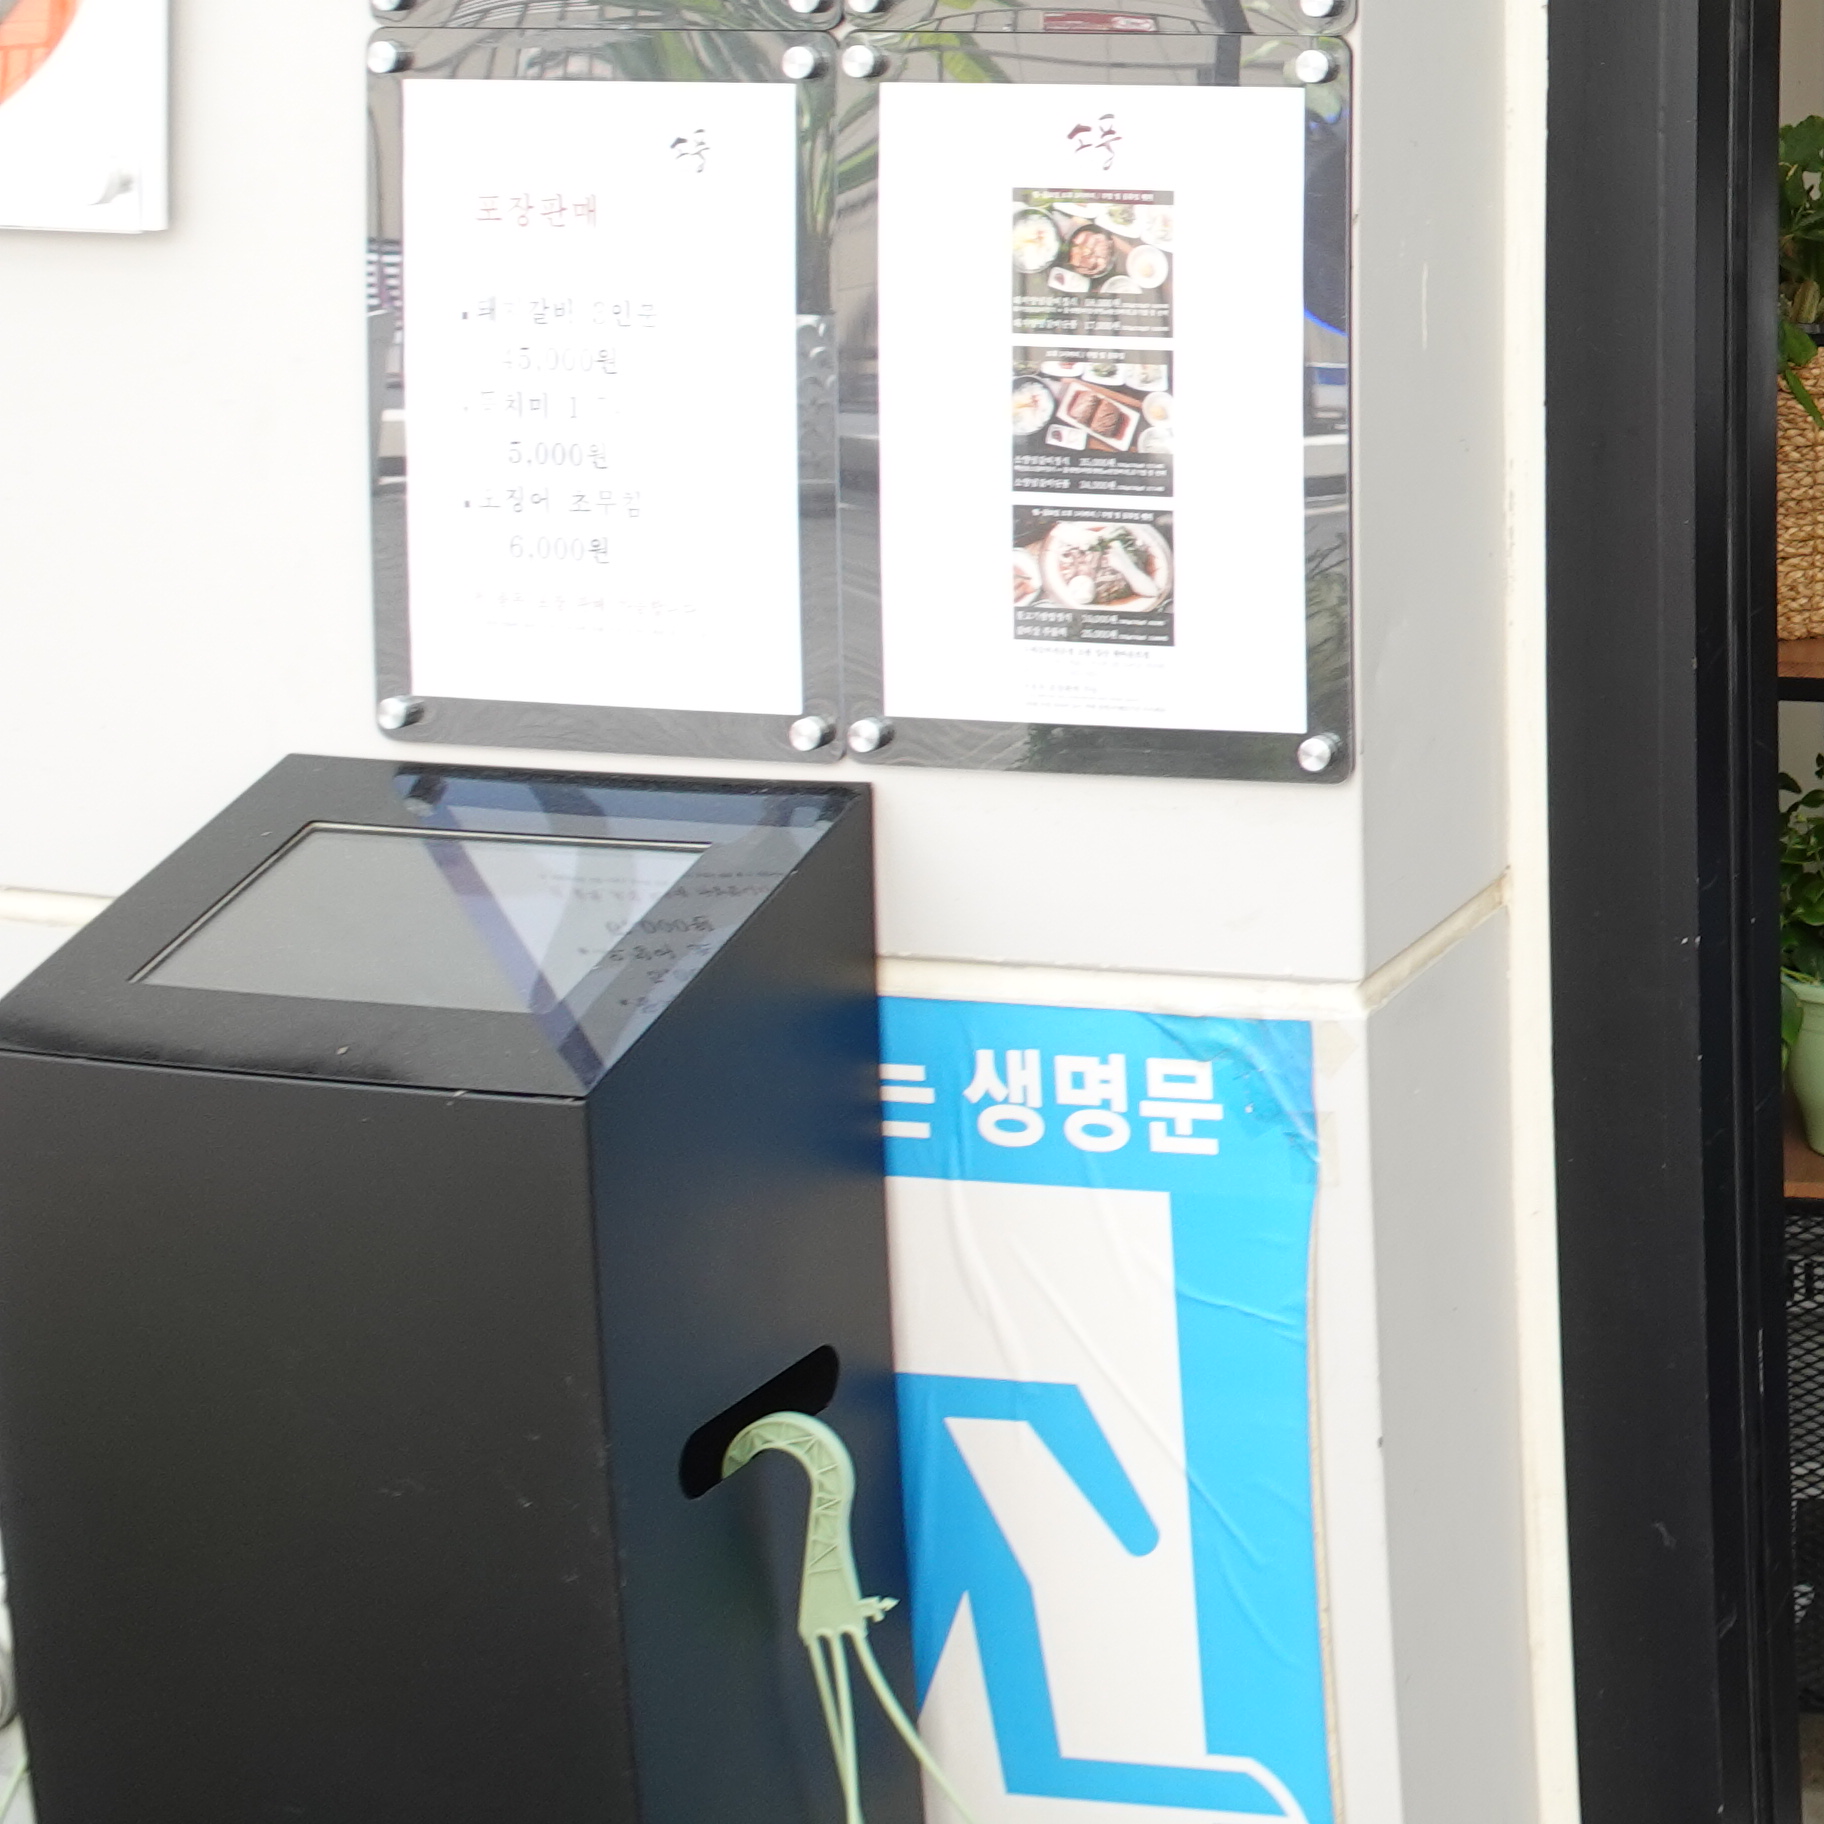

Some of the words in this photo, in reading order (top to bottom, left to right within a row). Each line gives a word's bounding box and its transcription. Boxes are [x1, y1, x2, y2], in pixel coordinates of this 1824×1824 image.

[476, 192, 597, 229] 포장판매
[475, 295, 574, 326] 돼갈비
[964, 1048, 1225, 1156] 생명문
